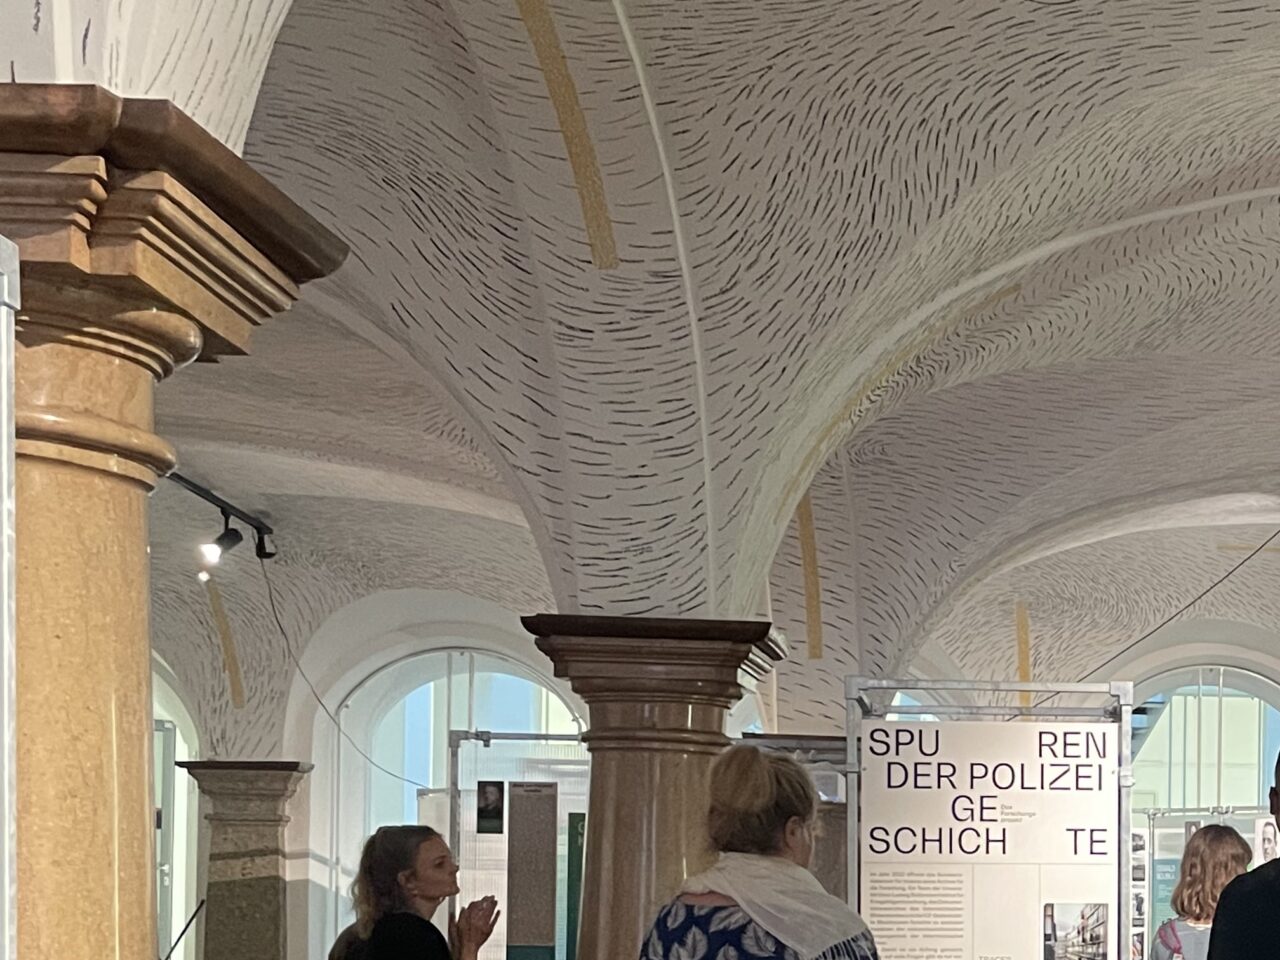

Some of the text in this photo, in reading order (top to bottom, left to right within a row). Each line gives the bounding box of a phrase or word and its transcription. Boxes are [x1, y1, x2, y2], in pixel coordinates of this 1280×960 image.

[868, 728, 1107, 759] SPU REN
[886, 762, 1104, 791] DER POLIZEI
[951, 795, 999, 822] GE
[868, 826, 1108, 856] SCHICH TE
